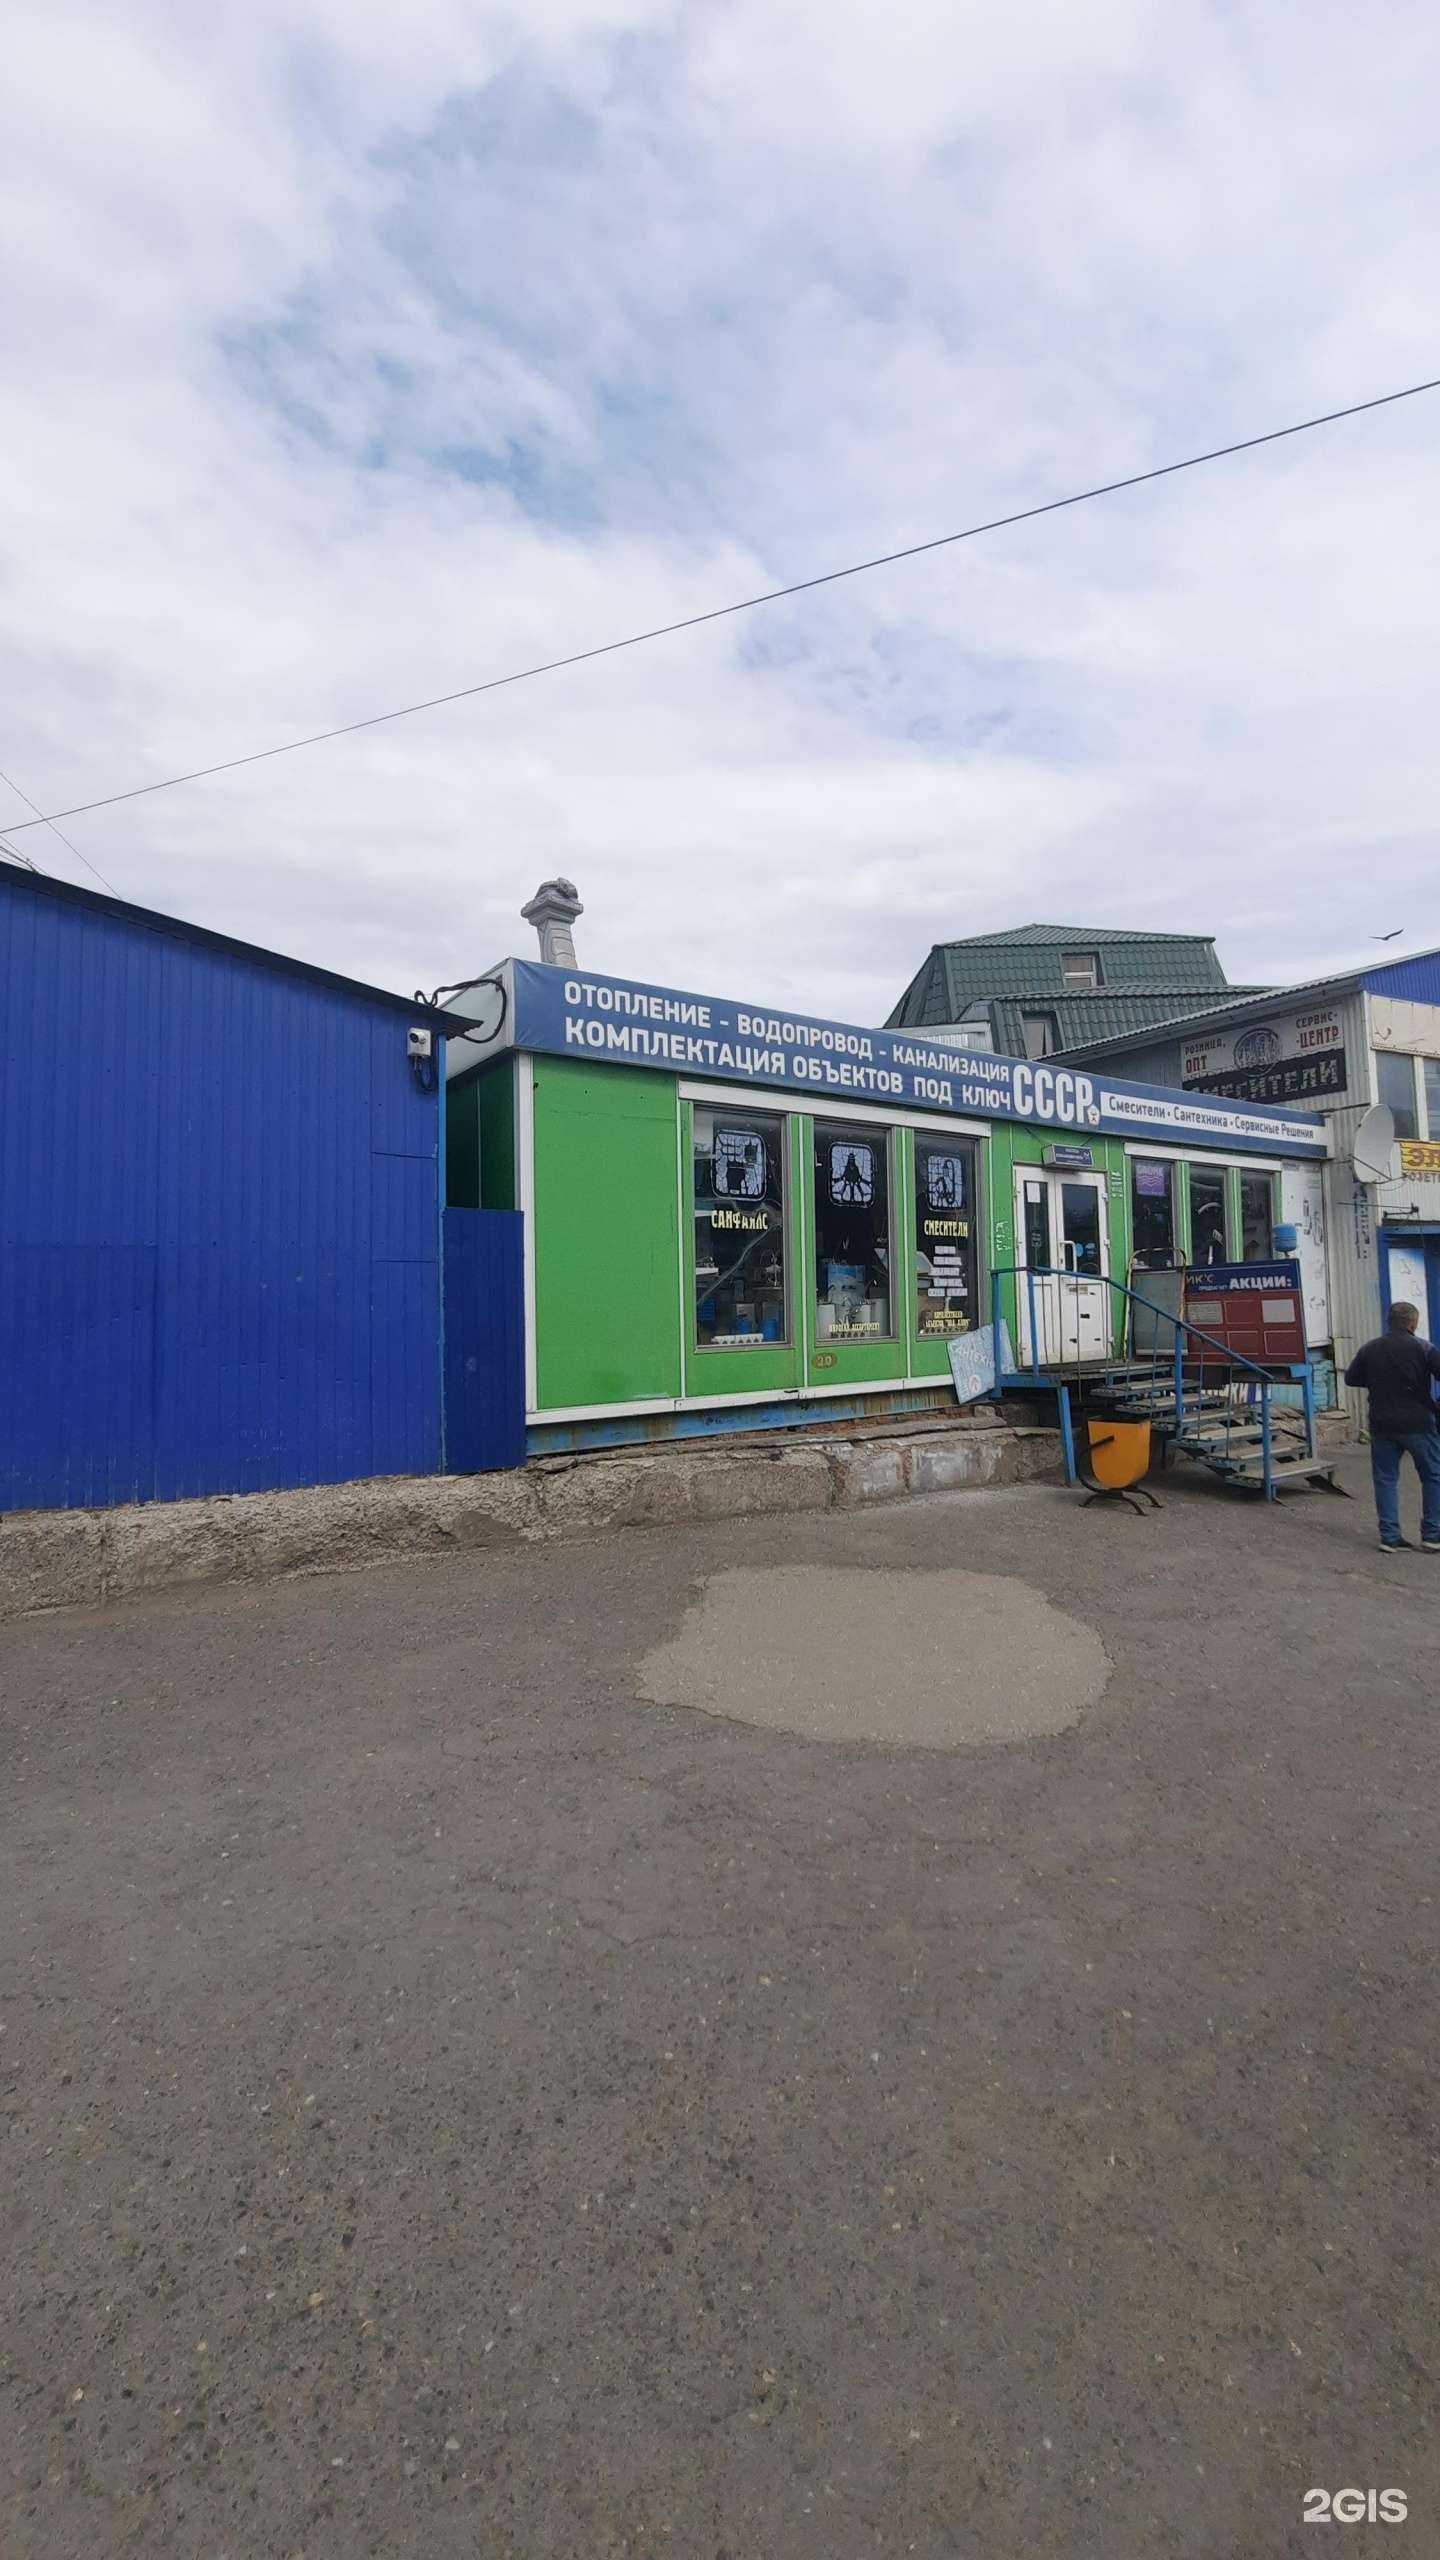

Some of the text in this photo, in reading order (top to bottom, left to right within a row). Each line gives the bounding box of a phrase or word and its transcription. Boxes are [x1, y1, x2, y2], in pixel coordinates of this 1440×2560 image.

[564, 980, 712, 1029] ОТОПЛЕНИЕ
[737, 1013, 873, 1061] ВОДОПРОВОД
[893, 1044, 1010, 1083] КАНАЛИЗАЦИЯ
[565, 1016, 1011, 1111] КОМПЛЕКТАЦИЯ ОБЪЕКТОВ ПОД КЛЮЧ
[1185, 1055, 1208, 1074] ОПТ
[1012, 1064, 1094, 1124] СССР
[1108, 1095, 1314, 1140] Смесители Сантехника Сервисные Решения
[1229, 1274, 1293, 1291] АКЦИИ:
